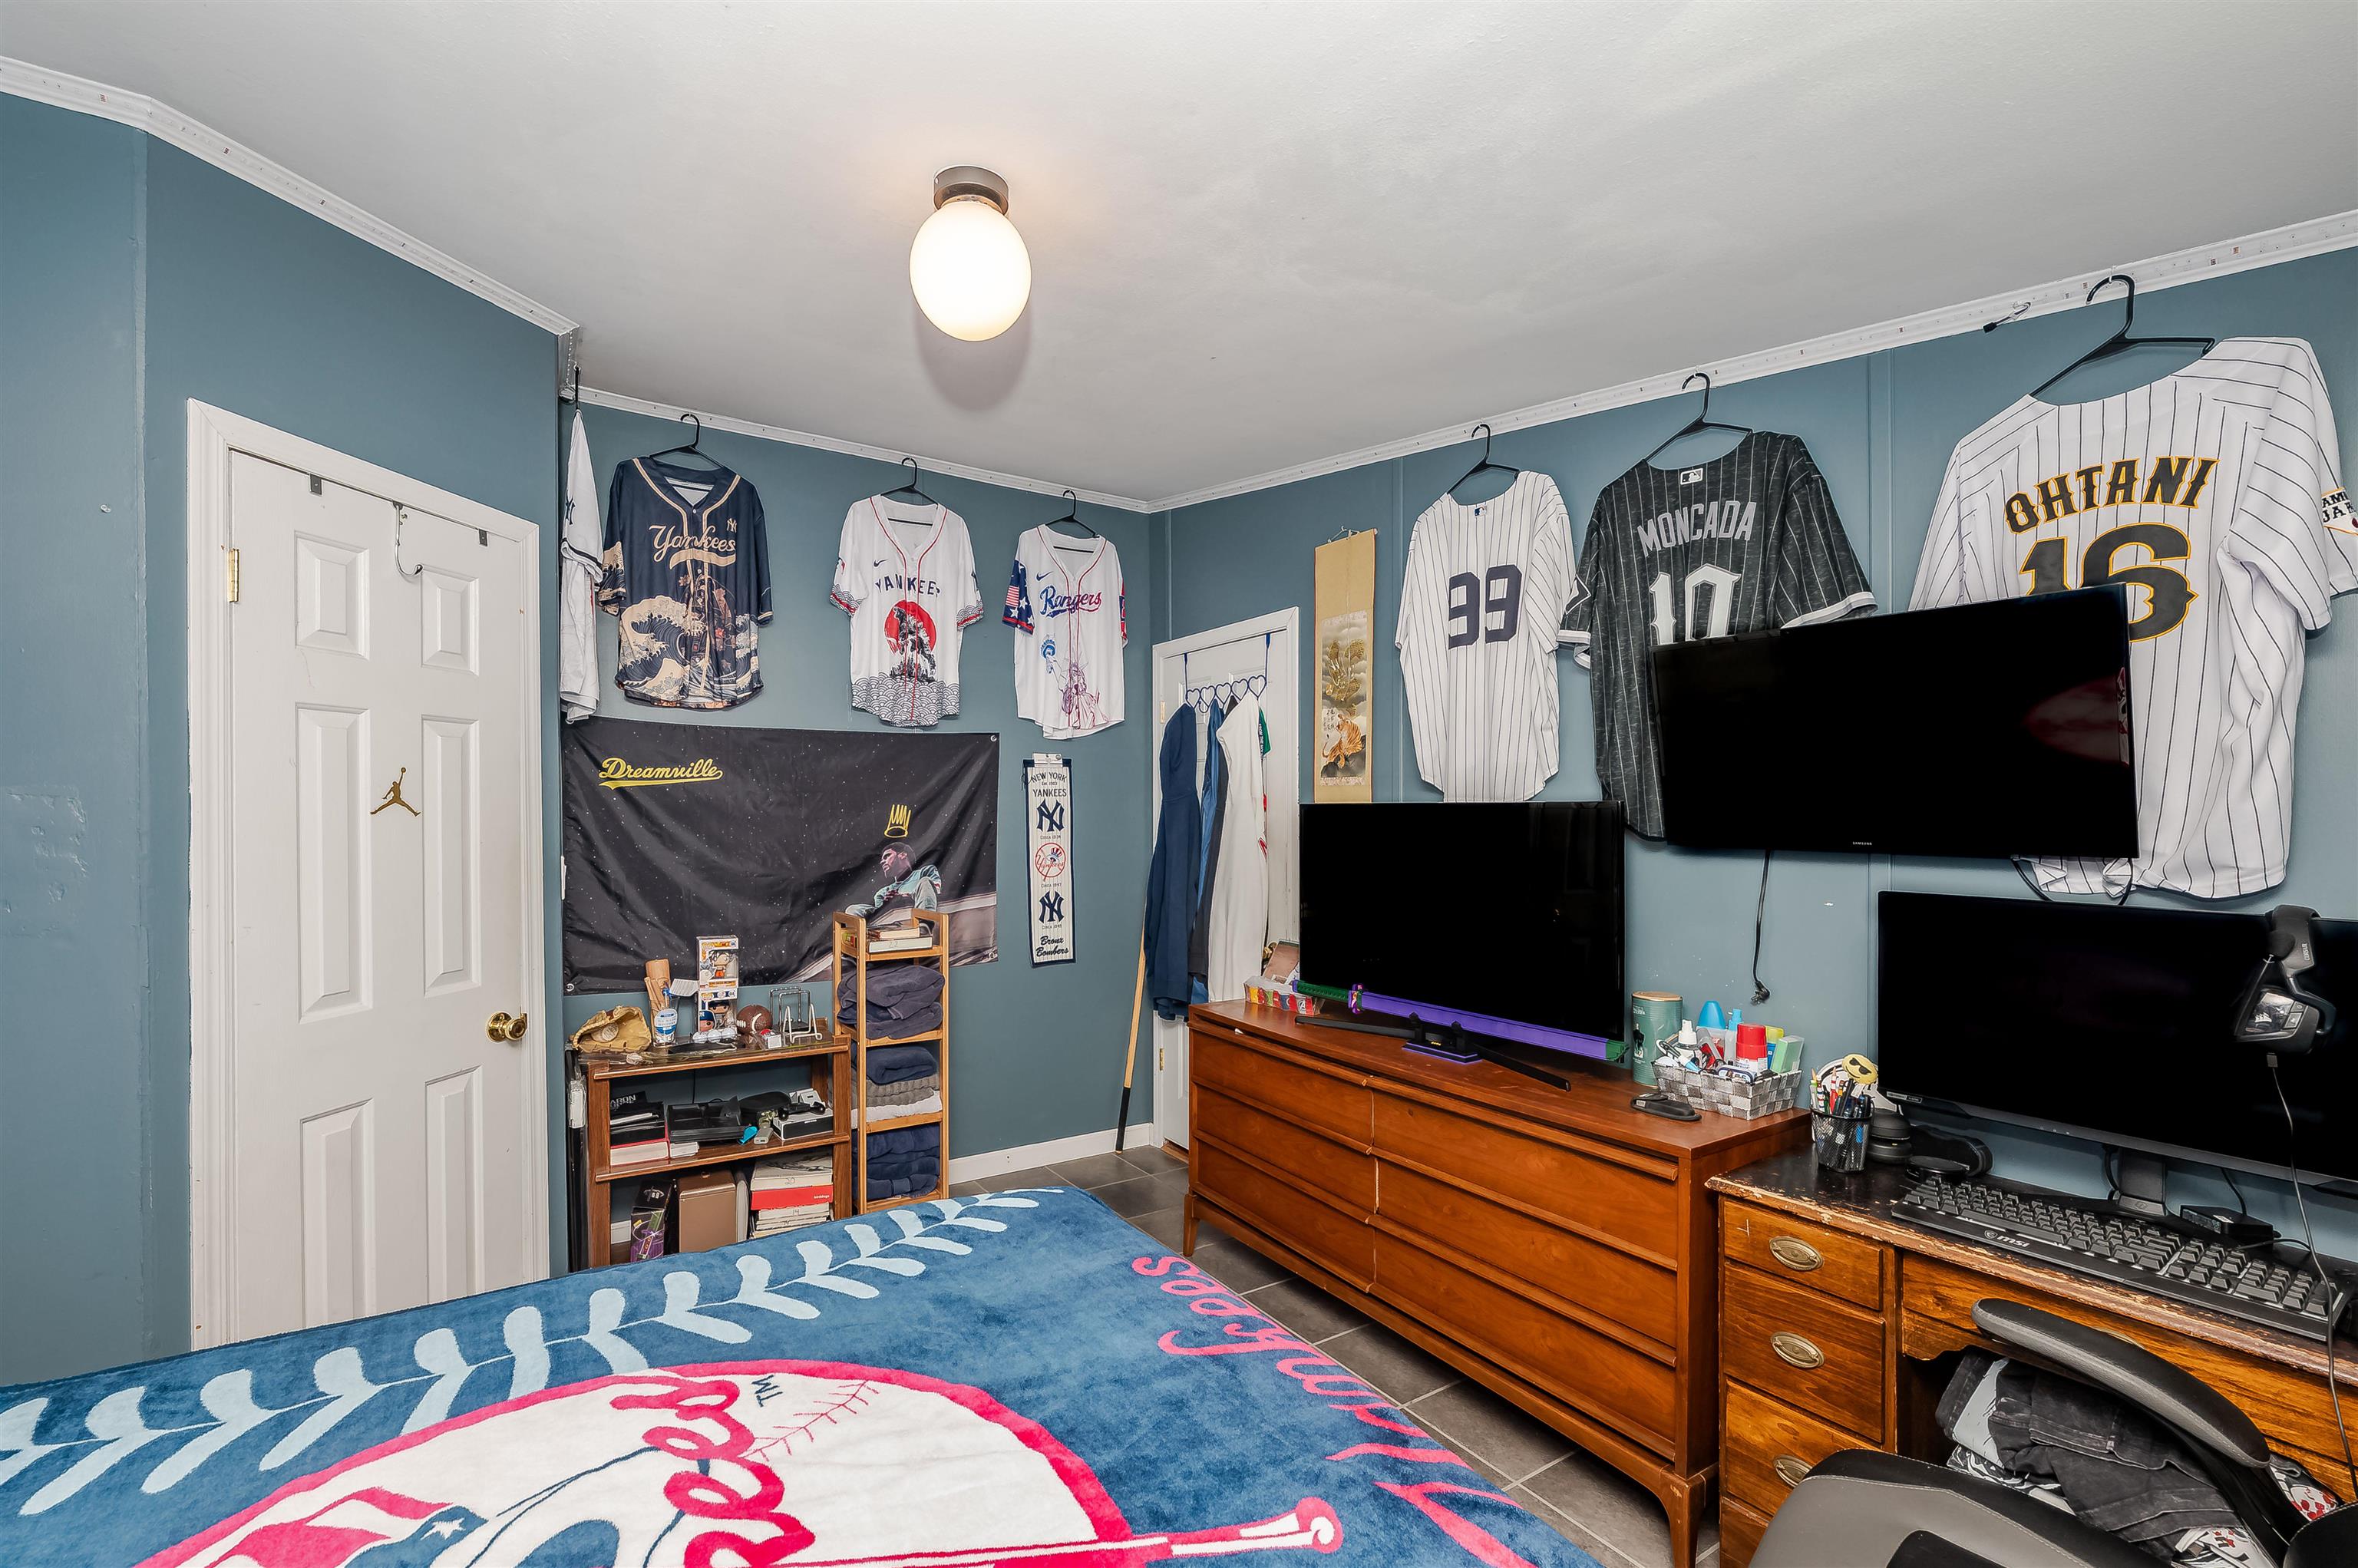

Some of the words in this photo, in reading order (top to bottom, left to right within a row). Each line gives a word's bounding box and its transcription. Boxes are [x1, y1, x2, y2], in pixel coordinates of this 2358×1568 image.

[2005, 455, 2221, 535] OHTANI
[649, 525, 736, 562] Yankees
[1636, 500, 1757, 557] MONCADA
[2019, 521, 2199, 642] 16
[1039, 585, 1102, 615] Rangers
[1448, 564, 1523, 650] 99
[1649, 563, 1742, 645] 10
[599, 757, 724, 782] Dreamville
[1031, 772, 1046, 783] NEW
[1049, 772, 1067, 782] YORK
[1032, 788, 1067, 797] YANKEES
[1036, 798, 1065, 832] NY
[1039, 890, 1065, 923] NY
[1035, 946, 1069, 957] Bombers
[1040, 936, 1064, 946] Bronx
[1997, 1236, 2030, 1247] msi
[751, 1375, 783, 1407] TM
